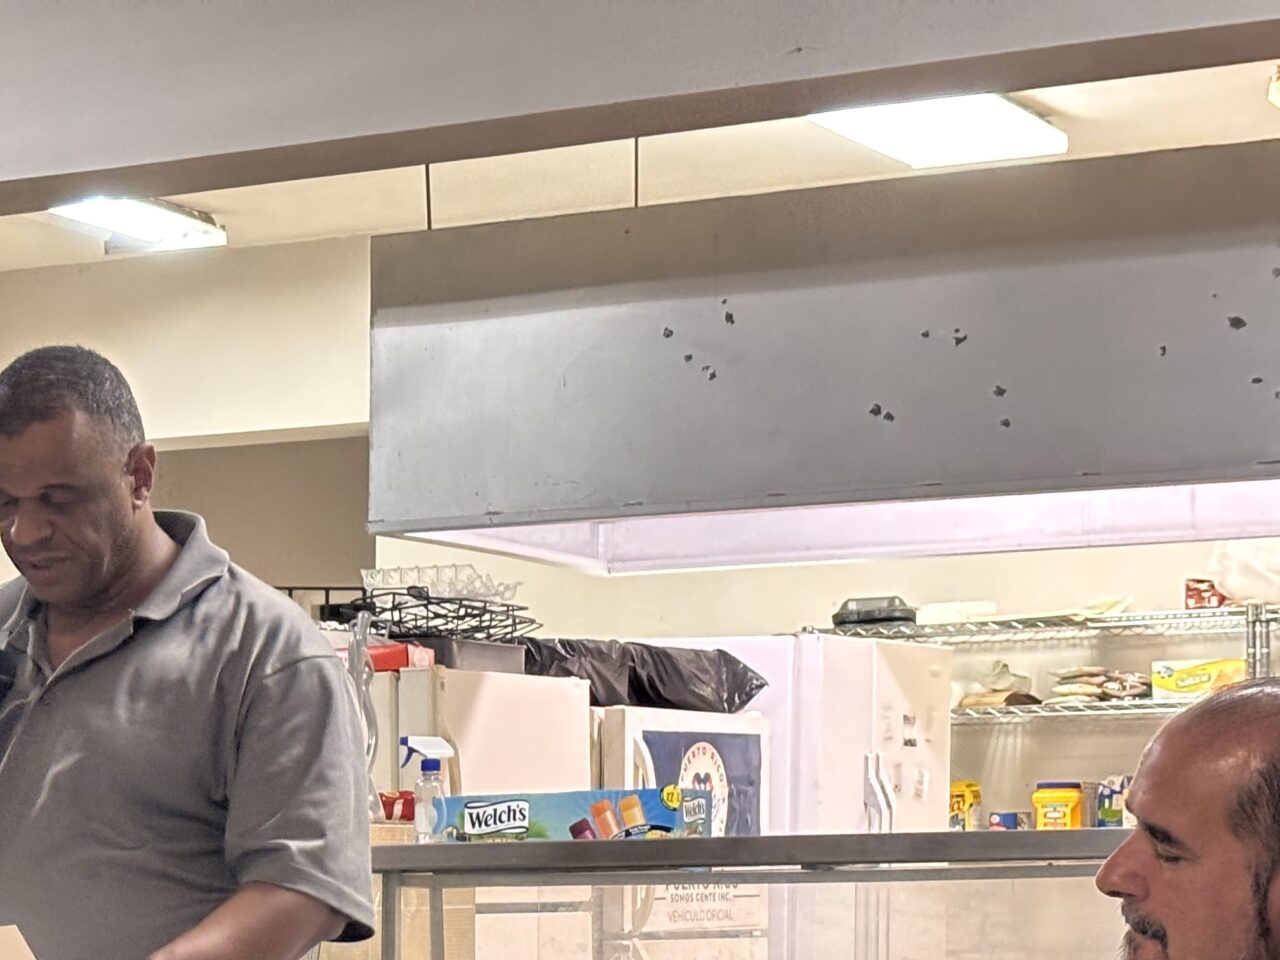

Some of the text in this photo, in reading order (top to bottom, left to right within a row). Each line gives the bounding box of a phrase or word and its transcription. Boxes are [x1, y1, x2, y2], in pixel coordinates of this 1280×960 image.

[467, 804, 527, 829] Welch's
[684, 800, 705, 818] Welch's
[670, 892, 694, 903] SOMOS
